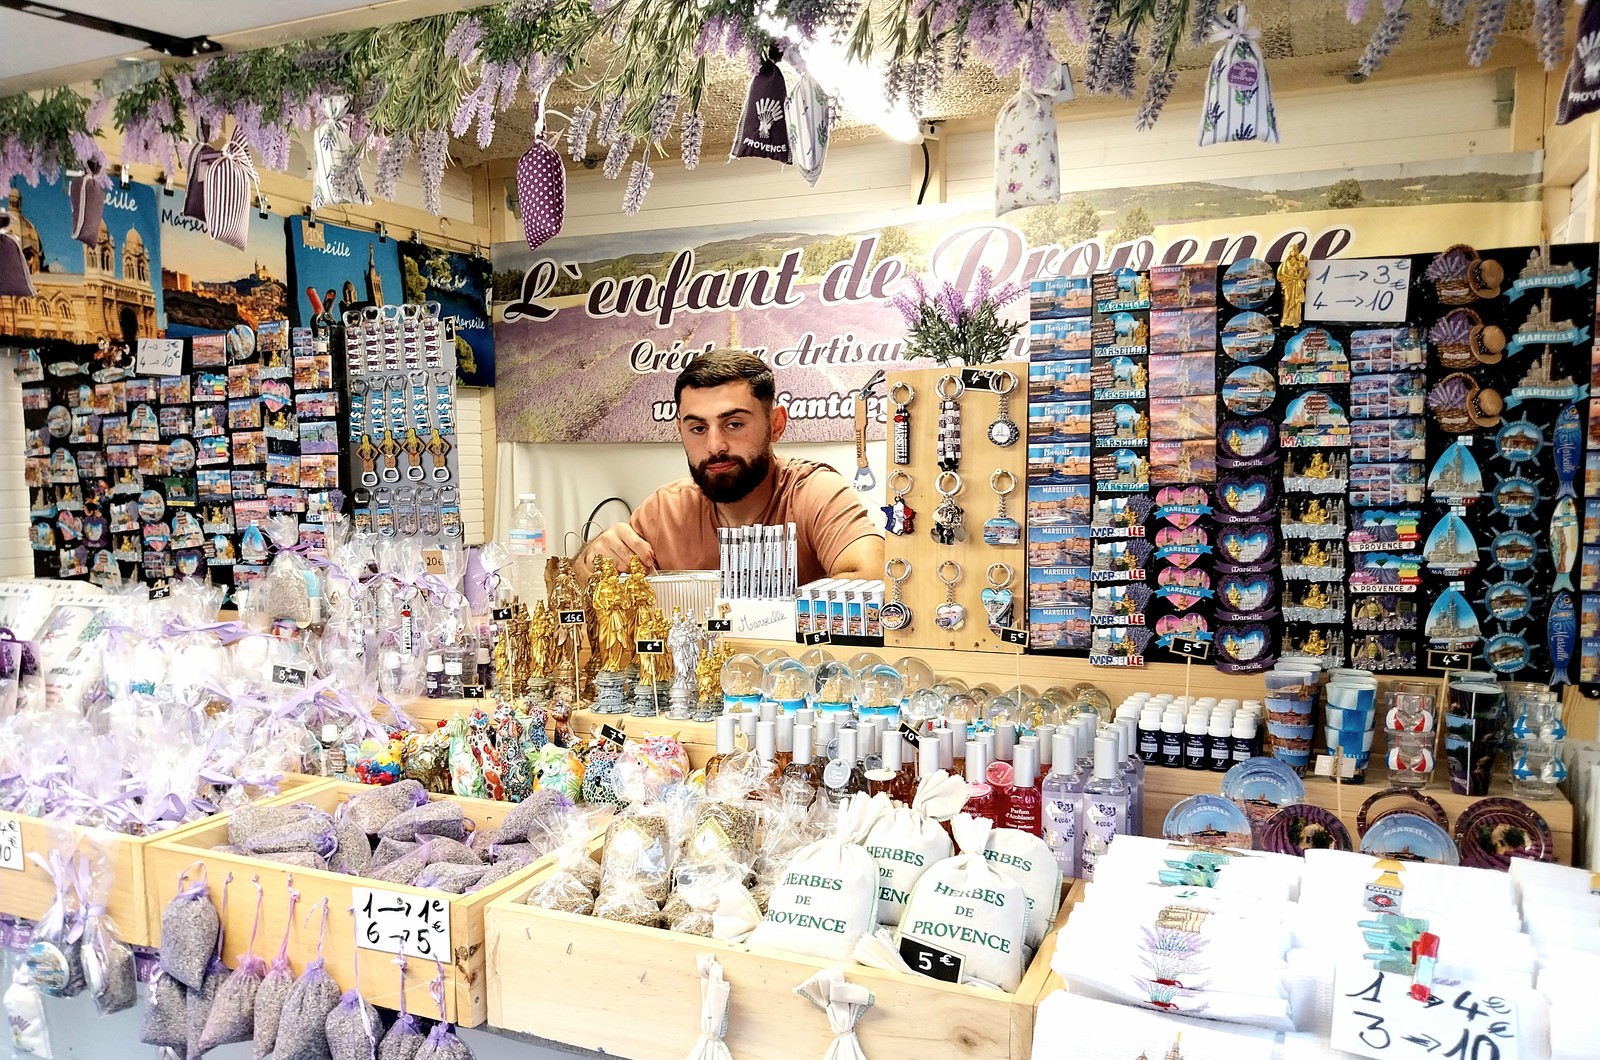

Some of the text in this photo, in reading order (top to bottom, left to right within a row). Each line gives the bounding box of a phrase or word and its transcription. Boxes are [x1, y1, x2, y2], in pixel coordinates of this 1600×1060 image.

[743, 137, 787, 153] PROVENCE
[823, 236, 903, 301] de
[1316, 258, 1410, 285] 1 3€
[1518, 274, 1576, 288] MARSEILLE
[1312, 279, 1407, 311] 4 10€
[1518, 332, 1575, 343] MARSEILLE
[1279, 371, 1351, 385] MARSEILLE
[1517, 388, 1574, 397] MARSEILLE
[1280, 434, 1352, 448] MARSEILLE
[1042, 486, 1075, 494] MARSEILLE
[234, 500, 267, 509] MARSEILLE
[1163, 506, 1200, 515] MARSEILLE
[1229, 515, 1260, 523] Marseille
[1042, 527, 1075, 535] MARSEILLE
[1163, 546, 1200, 554] MARSEILLE
[1359, 541, 1403, 551] PROVENCE
[1043, 568, 1076, 576] MARSEILLE
[1231, 565, 1262, 573] Marseille
[1165, 586, 1201, 597] MARSEILLE
[1360, 585, 1405, 593] PROVENCE
[564, 613, 582, 622] 15€
[738, 609, 787, 633] Marseille
[1010, 632, 1025, 643] 5€
[1442, 654, 1461, 665] 4€
[1231, 662, 1262, 671] Marseille
[1005, 812, 1035, 821] d'Ambiance
[1010, 807, 1030, 815] Parfum
[1383, 826, 1433, 844] MARSEILLE
[866, 845, 925, 867] HERBES
[878, 867, 894, 879] DE
[783, 872, 843, 891] HERBES
[794, 894, 813, 906] DE
[934, 881, 1006, 907] HERBES
[362, 892, 373, 919] 1
[954, 905, 975, 918] DE
[764, 909, 847, 934] ROVENCE
[366, 920, 445, 954] 6 5€
[912, 920, 1011, 954] PROVENCE
[918, 951, 955, 971] 5€
[1345, 971, 1512, 1022] 1 4€
[1352, 1010, 1391, 1050] 3
